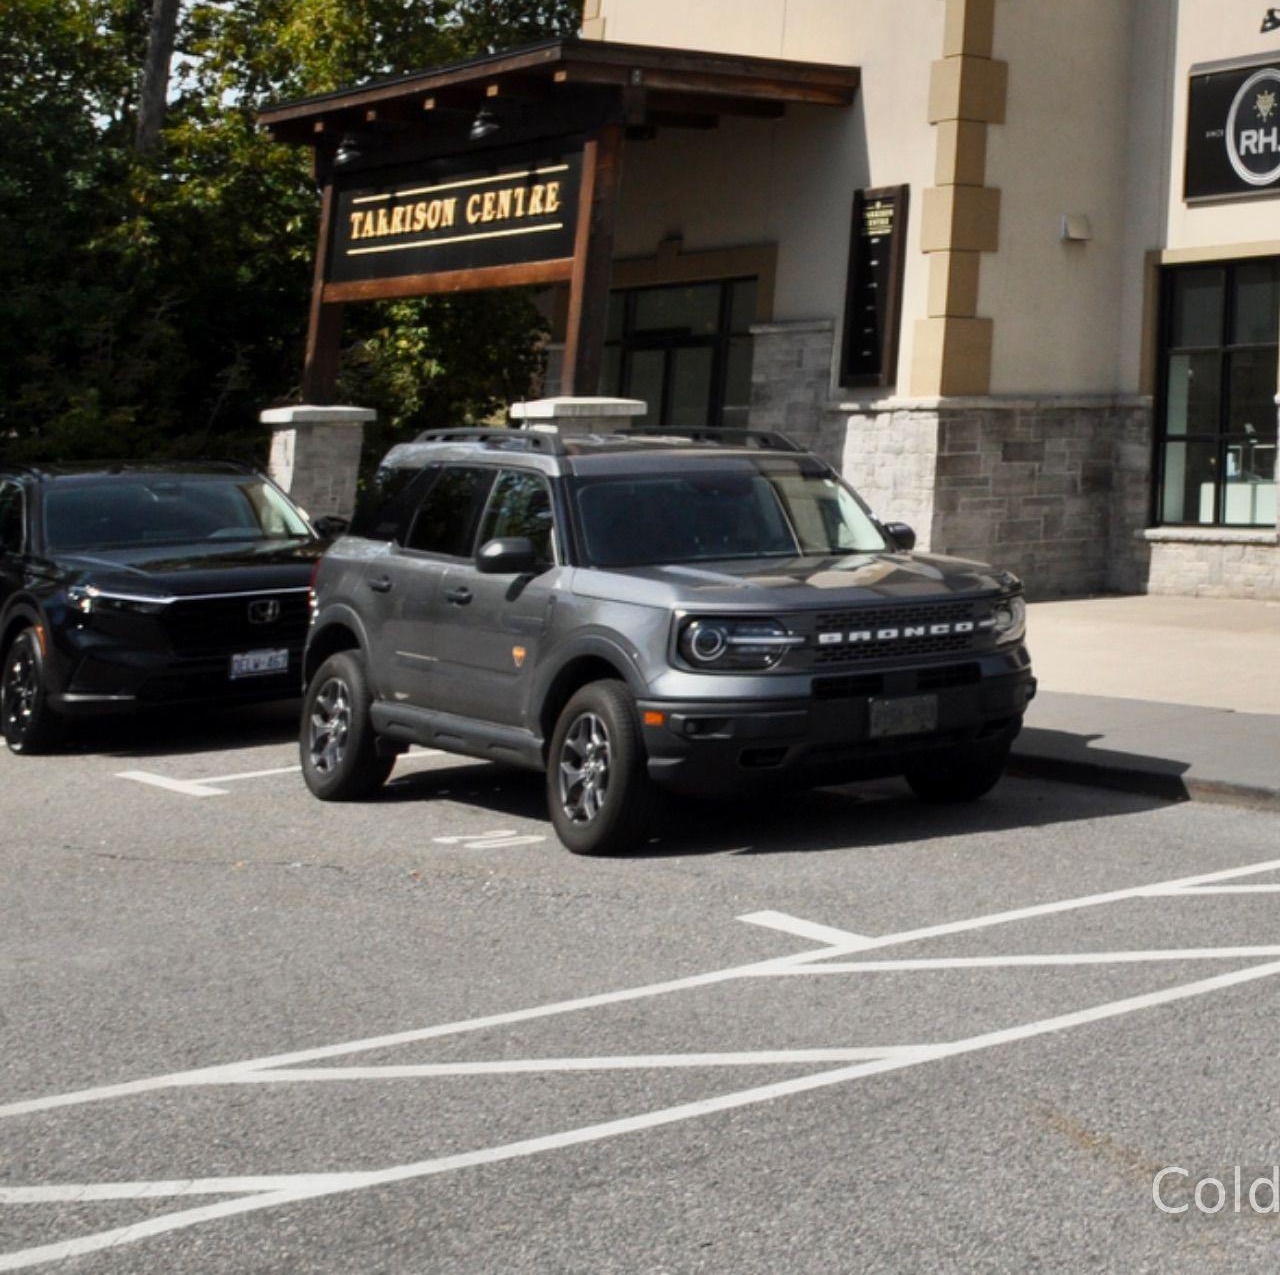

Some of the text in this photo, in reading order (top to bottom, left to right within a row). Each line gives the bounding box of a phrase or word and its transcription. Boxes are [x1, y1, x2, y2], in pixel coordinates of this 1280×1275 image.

[351, 181, 561, 240] TARRISON CENTRE
[818, 621, 974, 644] BRONCO
